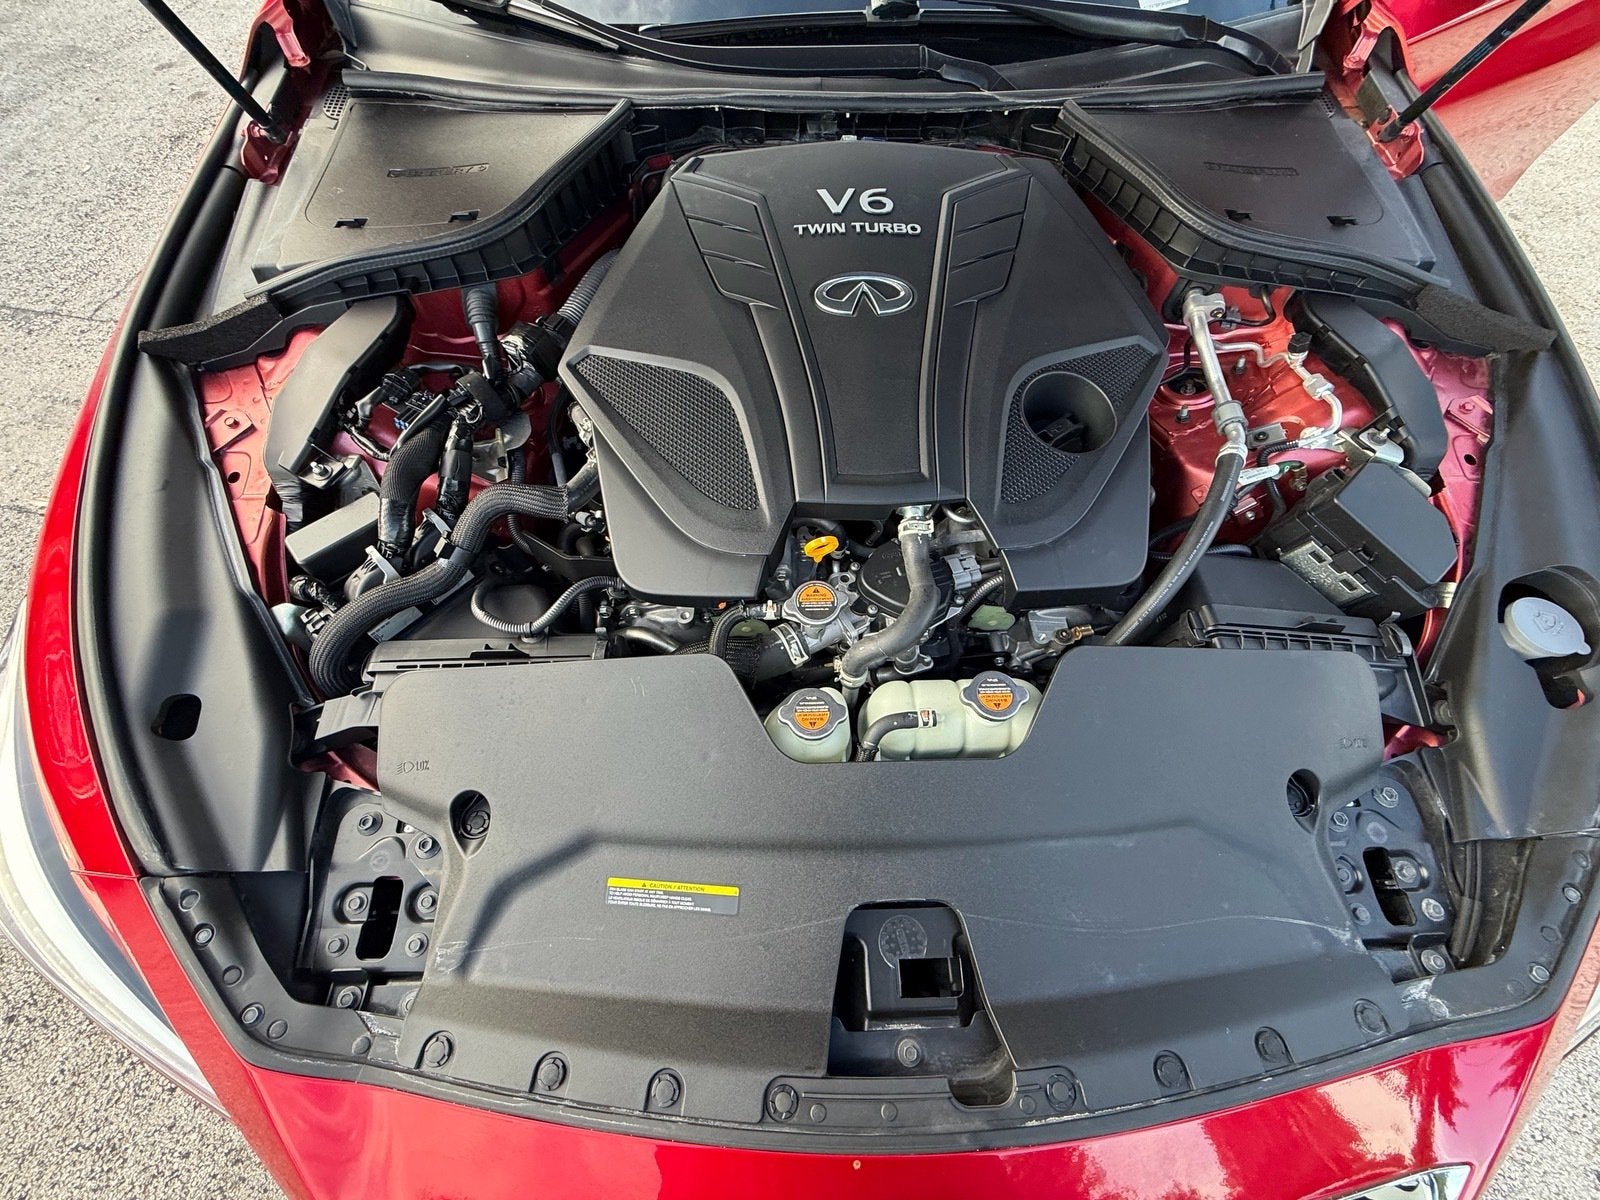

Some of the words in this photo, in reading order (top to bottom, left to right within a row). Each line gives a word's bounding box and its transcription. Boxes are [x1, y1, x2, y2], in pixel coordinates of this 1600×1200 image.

[816, 188, 894, 215] V6
[793, 222, 846, 236] TWIN
[851, 222, 922, 235] TURBO
[676, 884, 705, 892] ATTENTION
